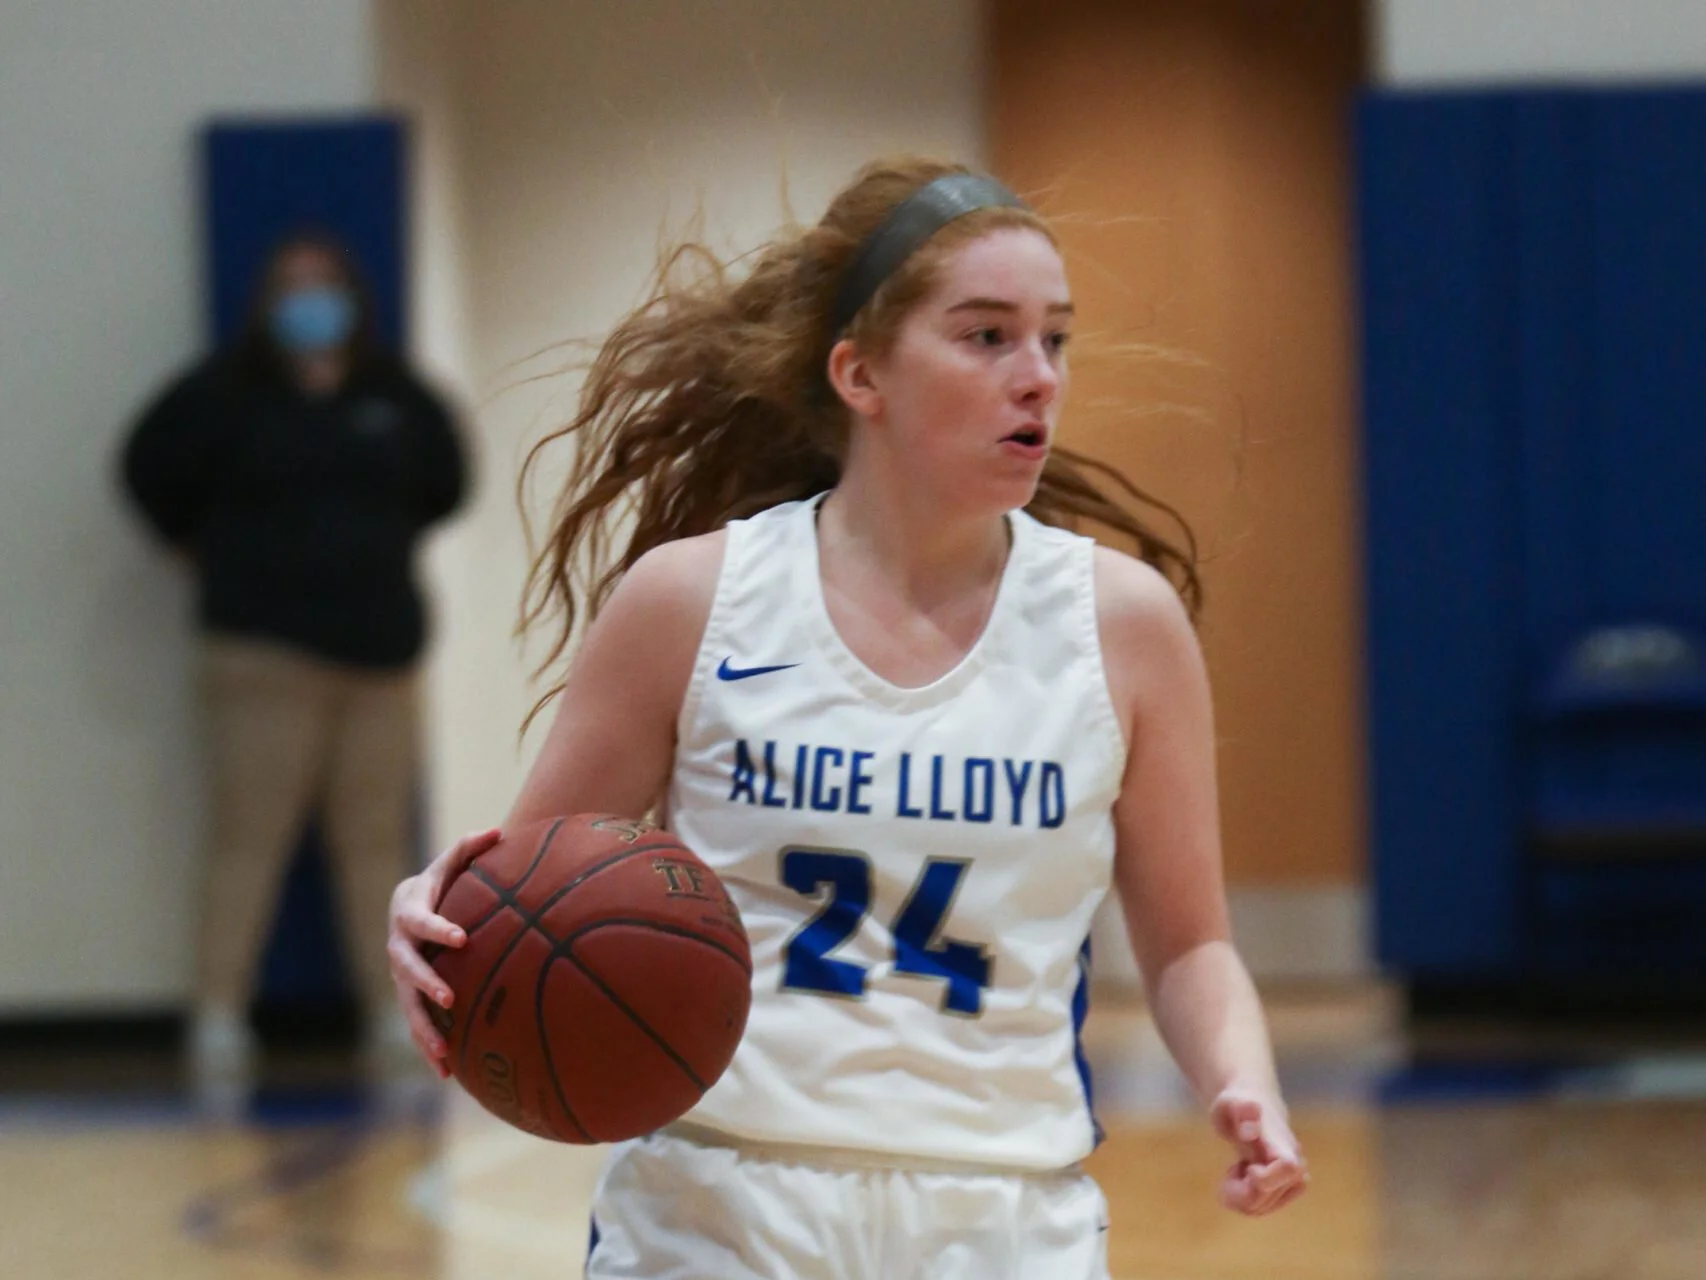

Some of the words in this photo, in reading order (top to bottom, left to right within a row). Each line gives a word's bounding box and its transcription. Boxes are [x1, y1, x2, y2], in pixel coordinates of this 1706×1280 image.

[729, 738, 875, 814] ALICE
[896, 752, 1066, 829] LLOYD
[777, 844, 994, 1020] 24
